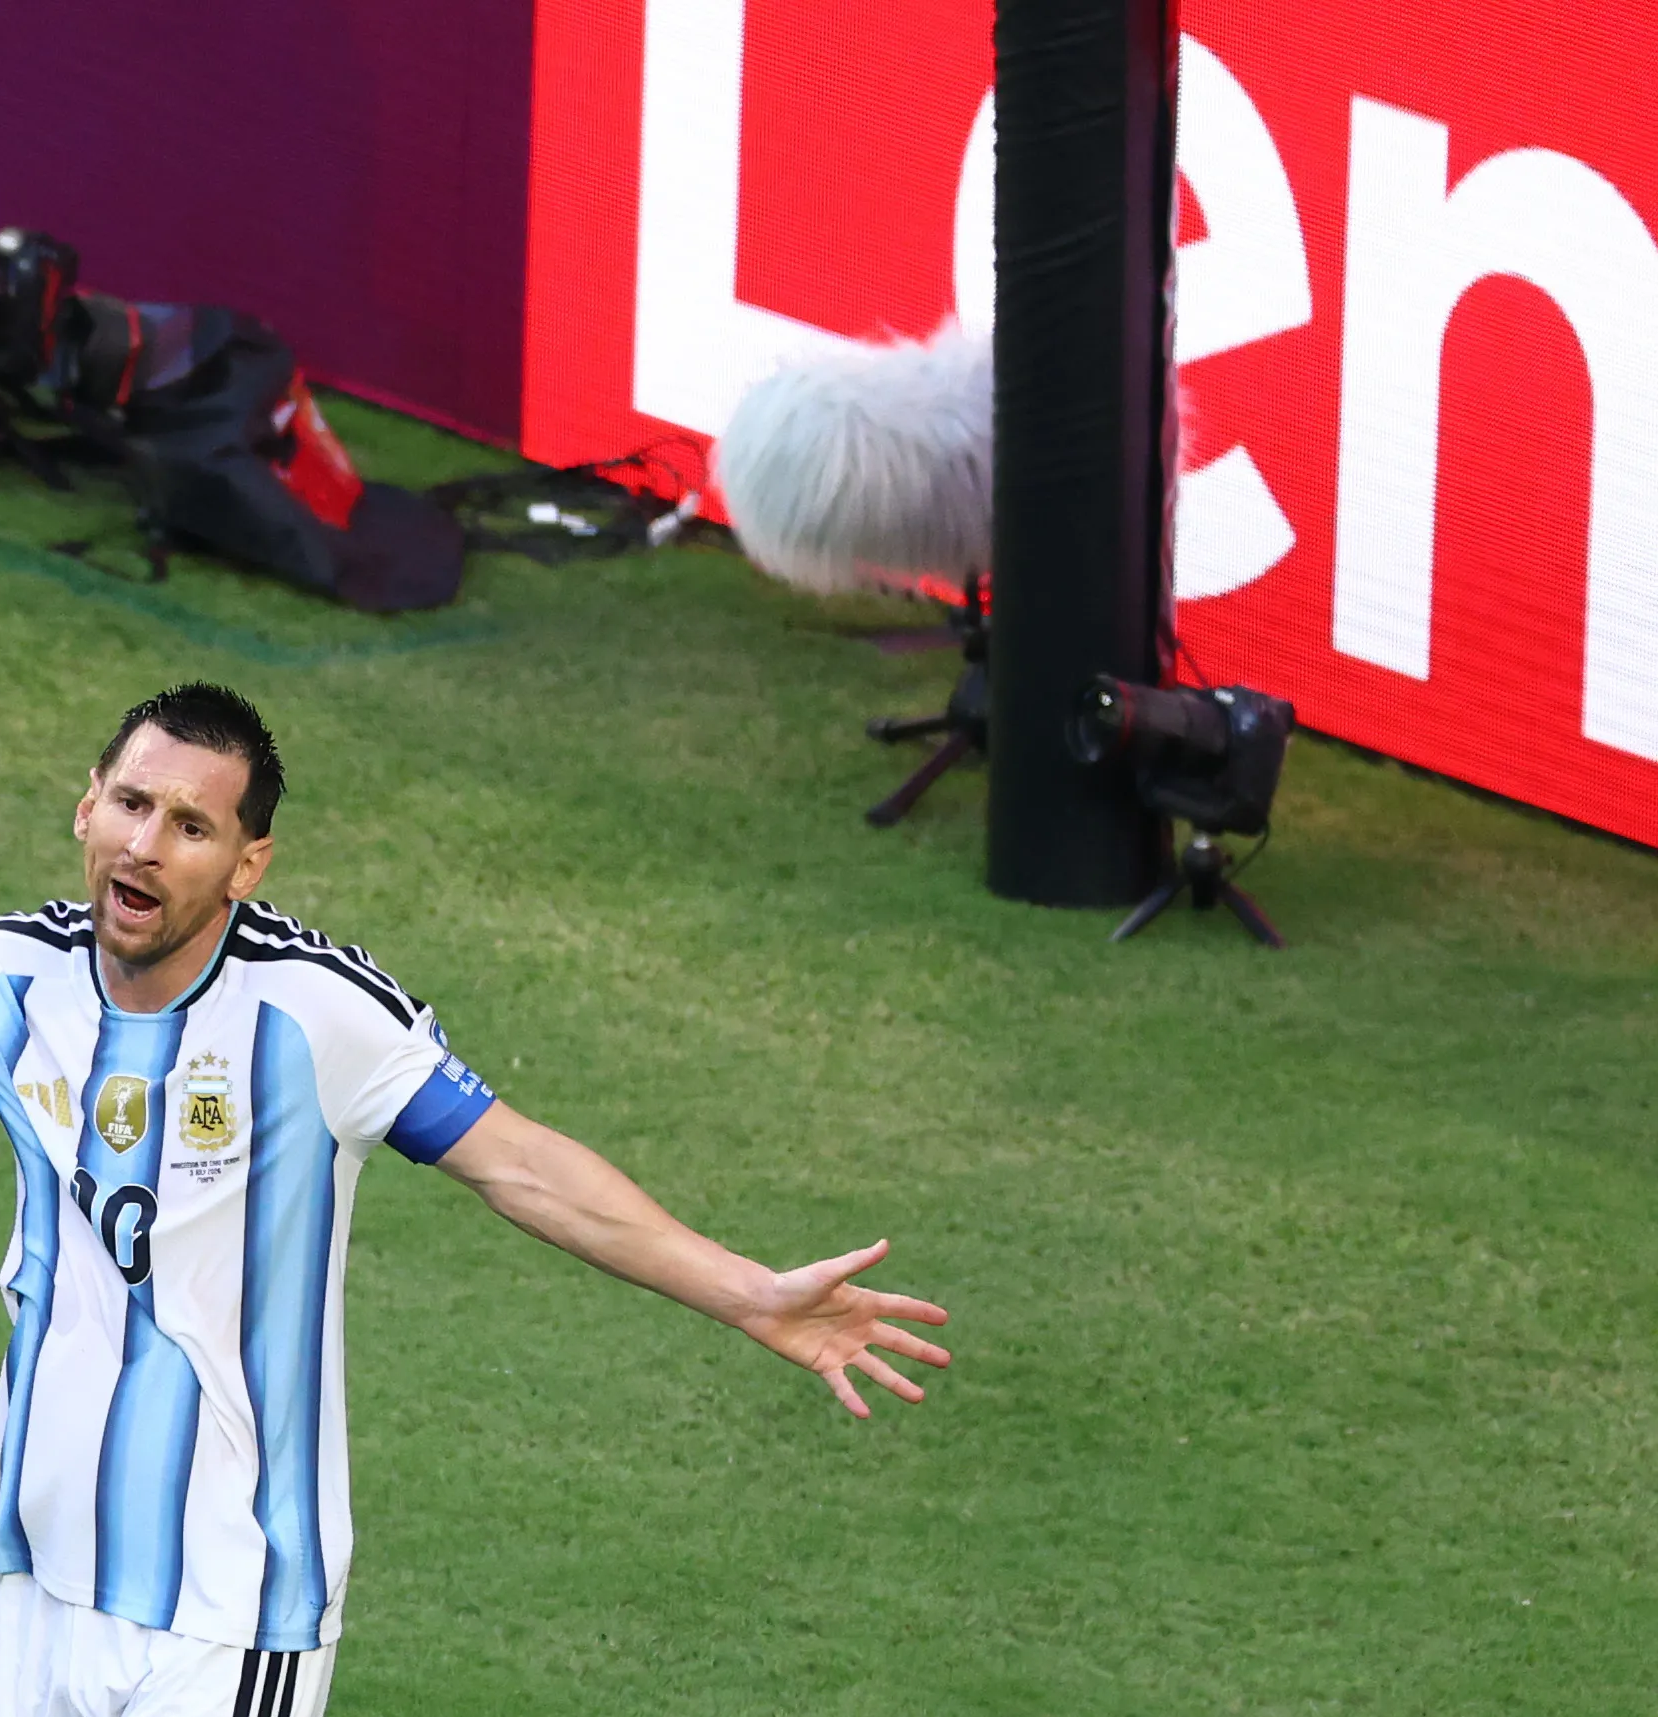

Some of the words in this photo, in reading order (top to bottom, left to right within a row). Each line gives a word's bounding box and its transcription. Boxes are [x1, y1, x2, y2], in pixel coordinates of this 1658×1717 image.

[106, 1122, 132, 1135] FIFA
[189, 1095, 224, 1131] AFA
[71, 1167, 158, 1286] 10
